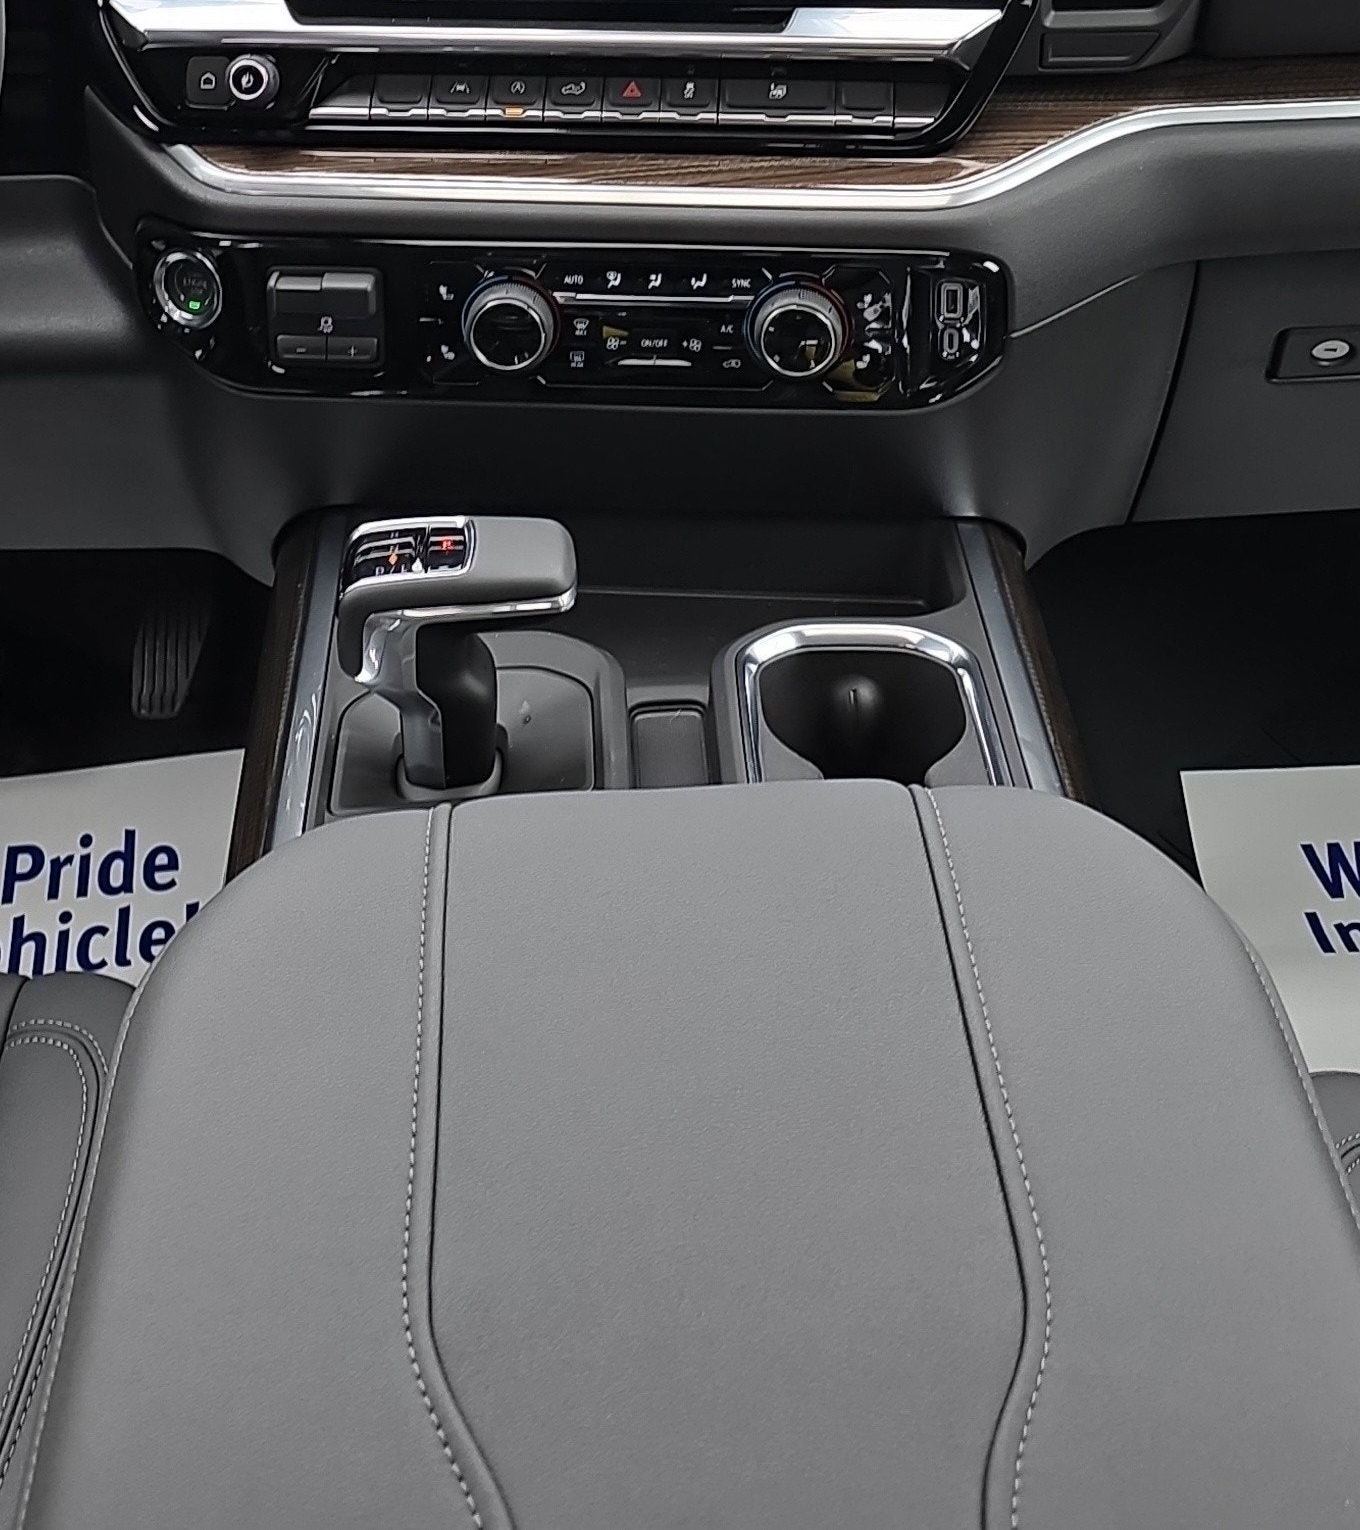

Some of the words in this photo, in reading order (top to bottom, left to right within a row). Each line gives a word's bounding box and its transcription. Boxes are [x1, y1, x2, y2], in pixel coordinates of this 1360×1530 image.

[564, 275, 584, 285] AUTO
[732, 278, 751, 288] SYNC
[720, 323, 734, 334] A/C
[641, 338, 668, 348] ON/OFF
[0, 827, 179, 907] Pride
